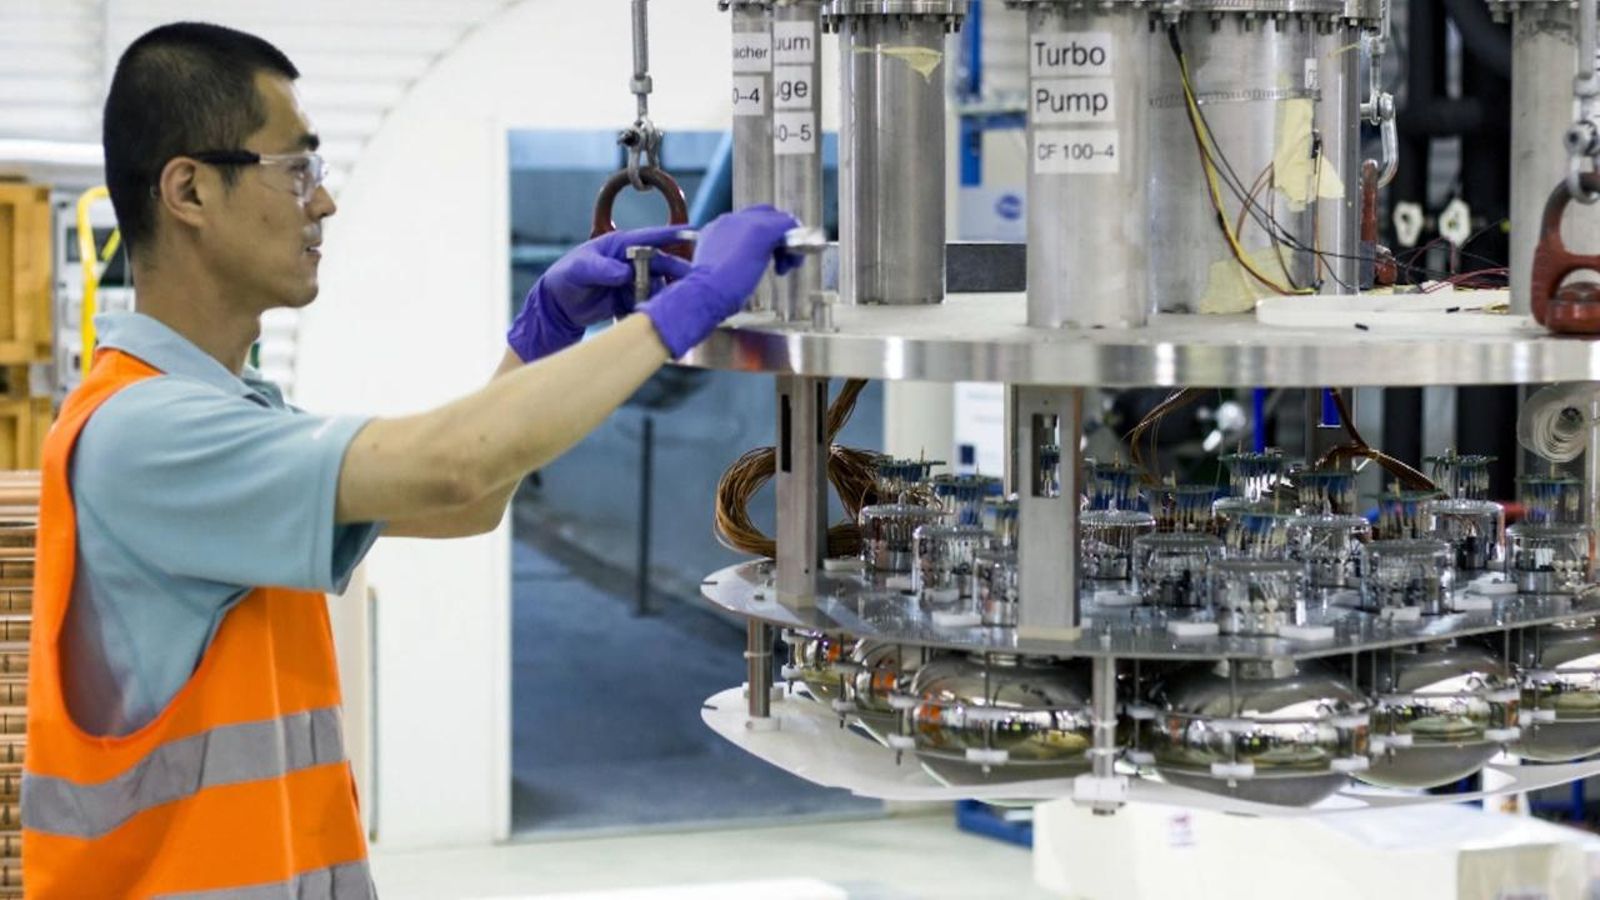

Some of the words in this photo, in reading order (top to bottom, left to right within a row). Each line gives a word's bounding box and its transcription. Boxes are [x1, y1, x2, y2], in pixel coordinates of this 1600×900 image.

[1034, 41, 1106, 67] Turbo
[1036, 88, 1108, 117] Pump
[1037, 143, 1057, 161] CF
[1063, 143, 1115, 160] 100-4
